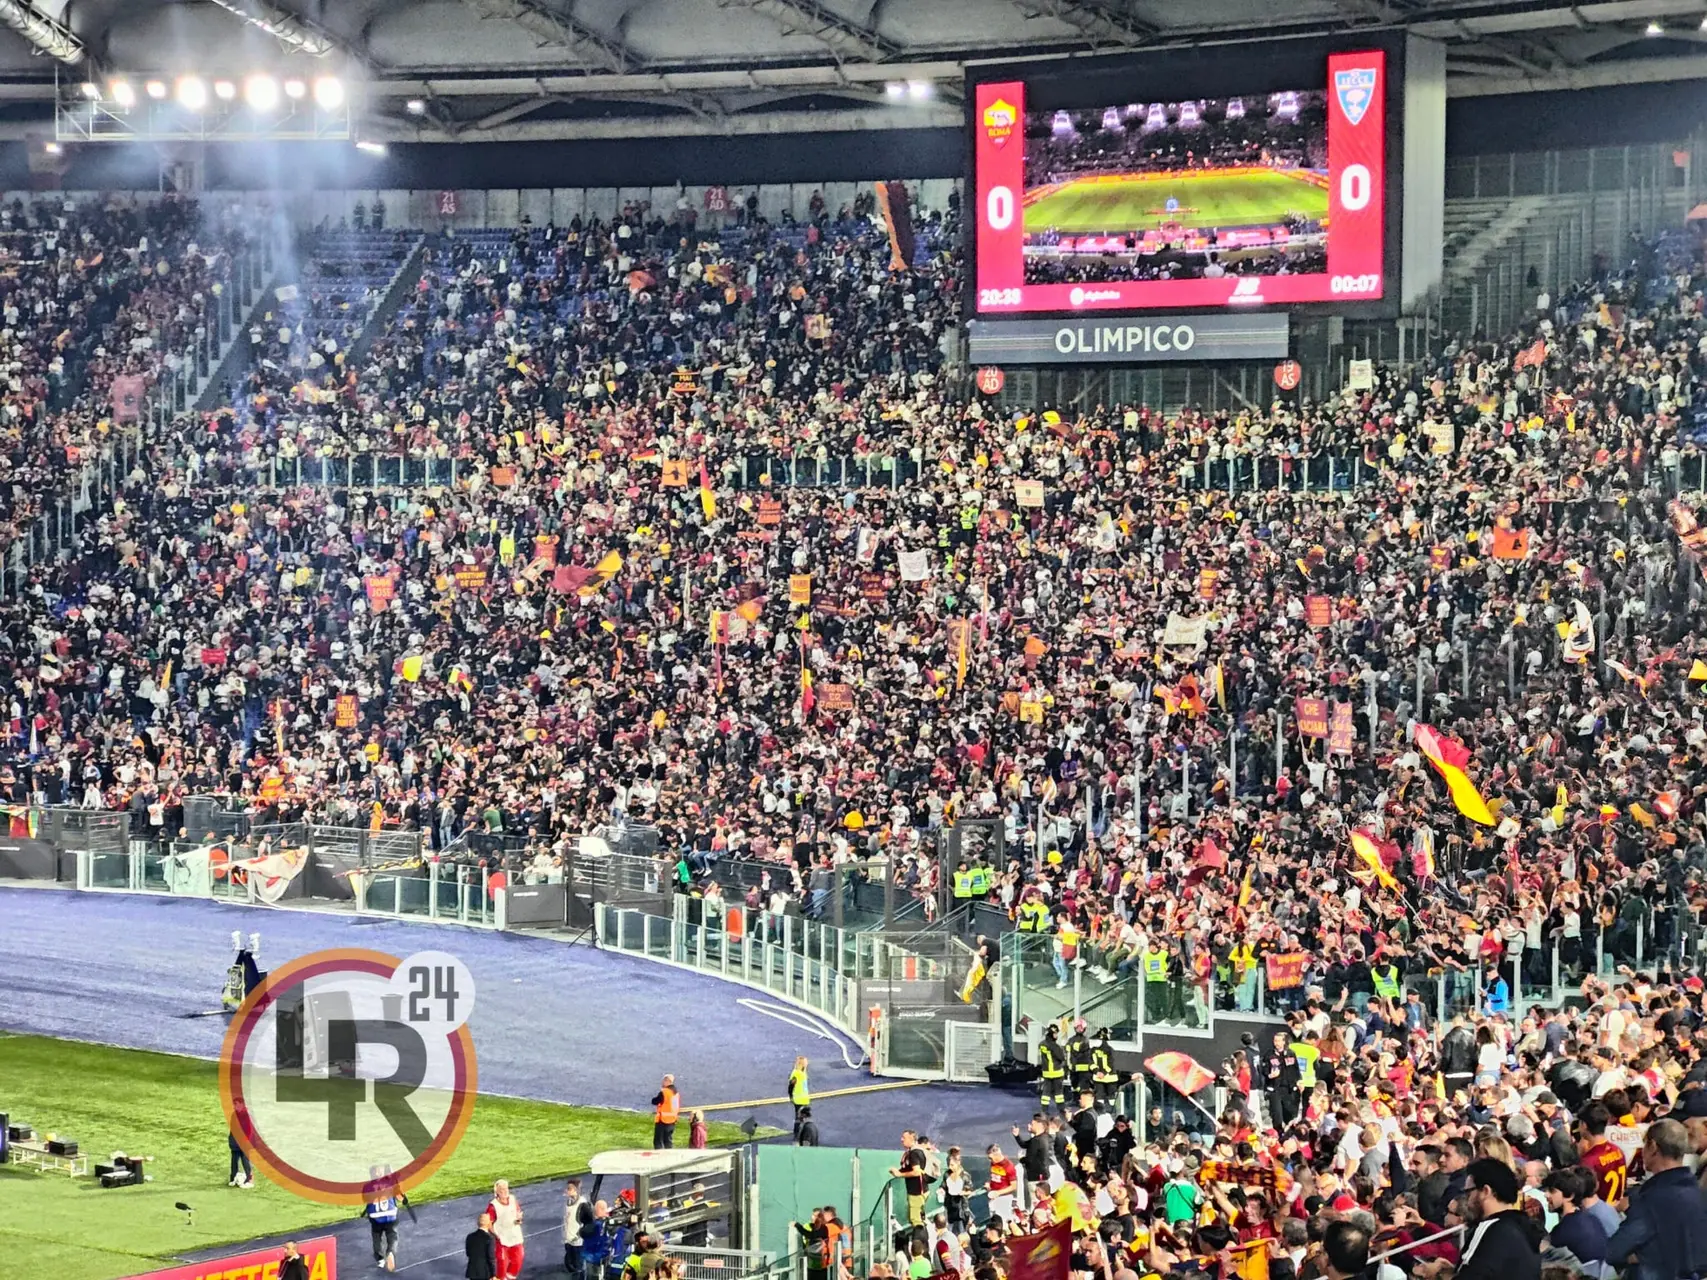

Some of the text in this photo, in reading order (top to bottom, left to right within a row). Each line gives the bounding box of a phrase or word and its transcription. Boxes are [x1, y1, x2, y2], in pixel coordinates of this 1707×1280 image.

[988, 126, 1011, 137] ROMA
[1340, 163, 1371, 211] 0
[442, 191, 454, 202] 21
[987, 185, 1014, 230] 0
[1330, 274, 1379, 294] 00:07
[1054, 325, 1196, 354] OLIMPICO
[985, 365, 998, 377] 20
[983, 378, 999, 391] AD
[1281, 373, 1295, 386] AS
[1604, 1164, 1627, 1206] 21
